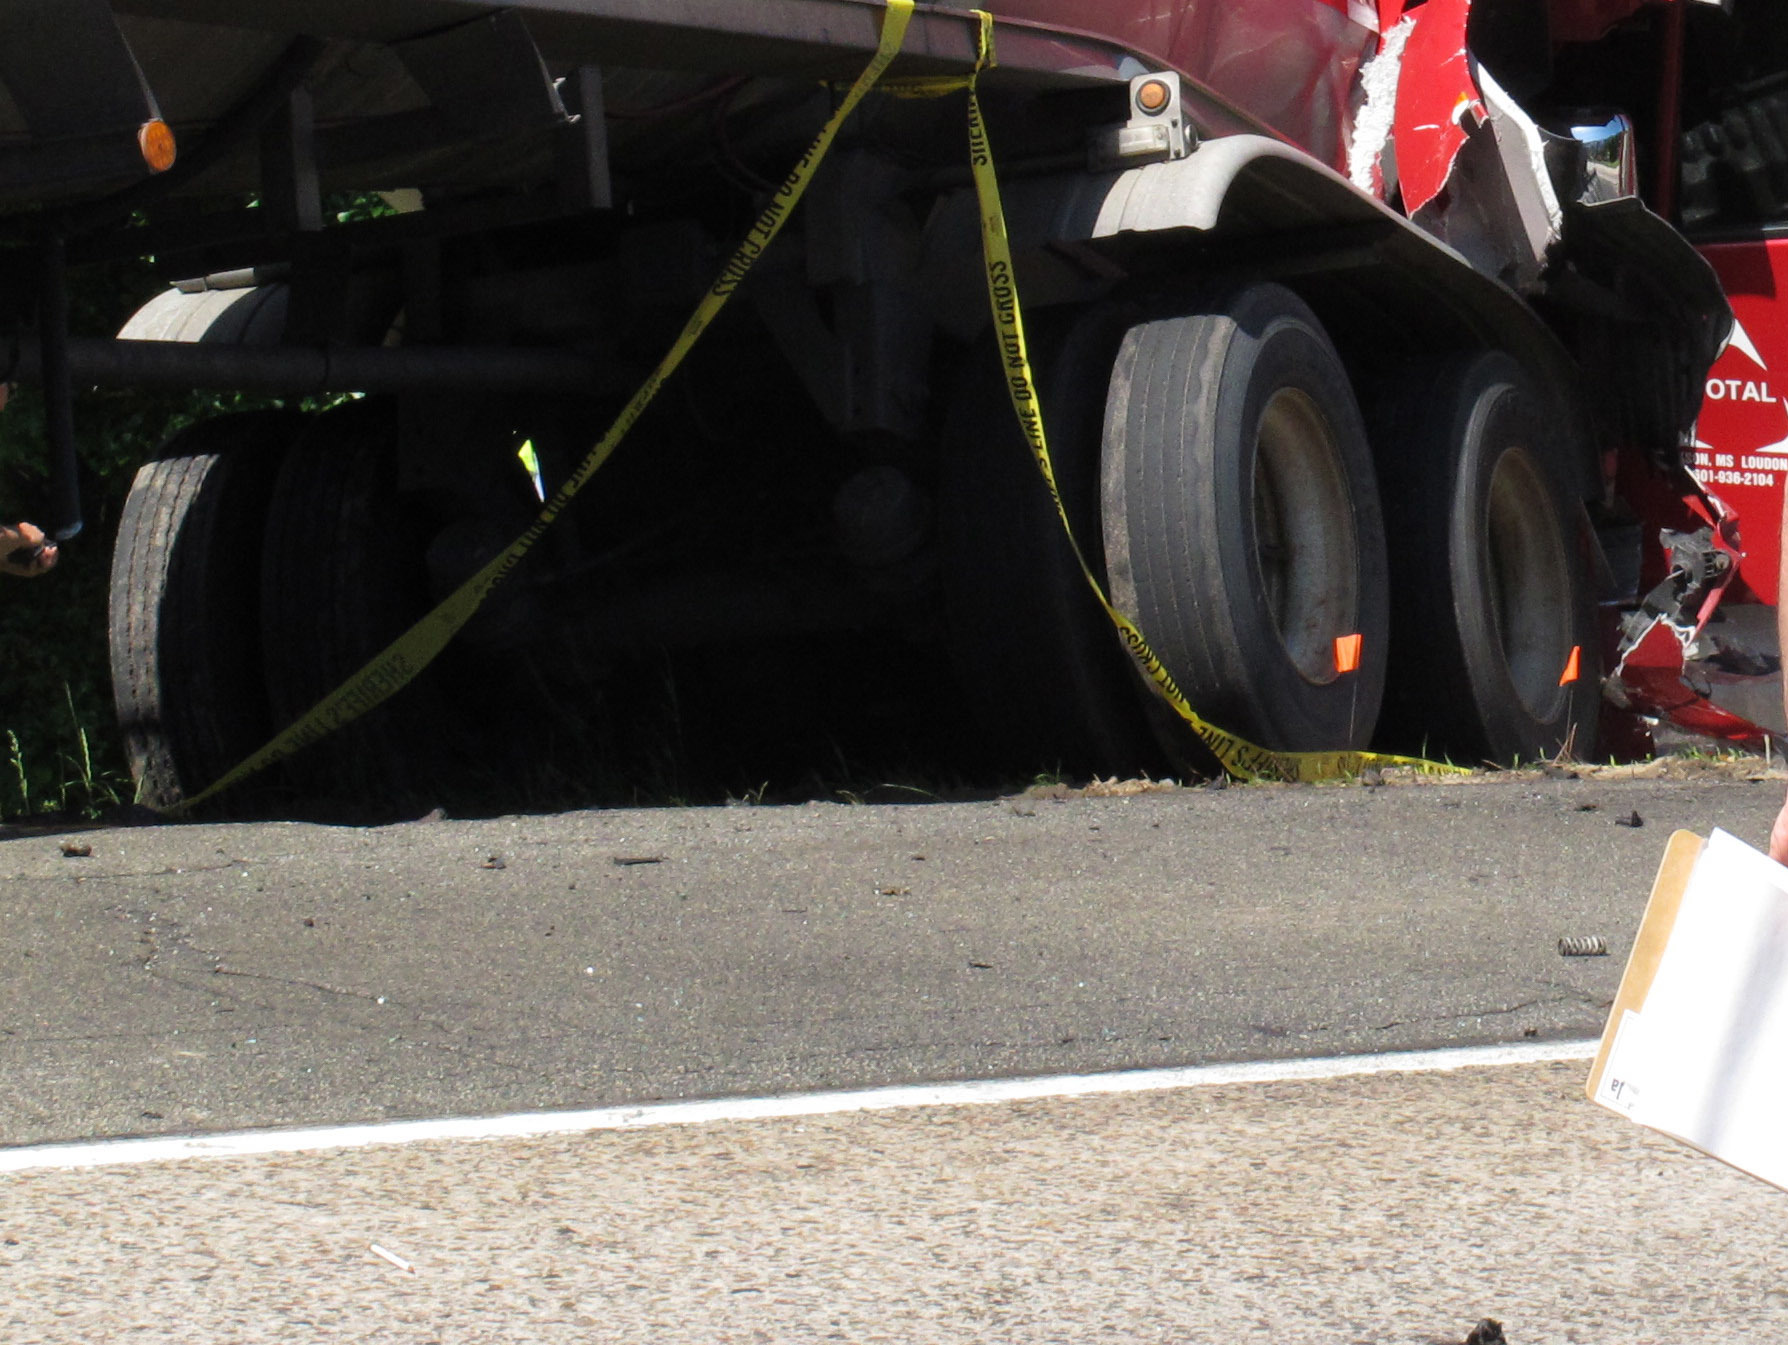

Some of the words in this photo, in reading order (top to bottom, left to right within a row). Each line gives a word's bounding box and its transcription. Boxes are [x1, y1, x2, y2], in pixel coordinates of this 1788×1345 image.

[751, 199, 786, 237] NOT
[1002, 331, 1024, 368] NOT
[1705, 378, 1777, 403] OTAL
[1715, 454, 1734, 467] MS
[1741, 455, 1788, 471] LOUDON
